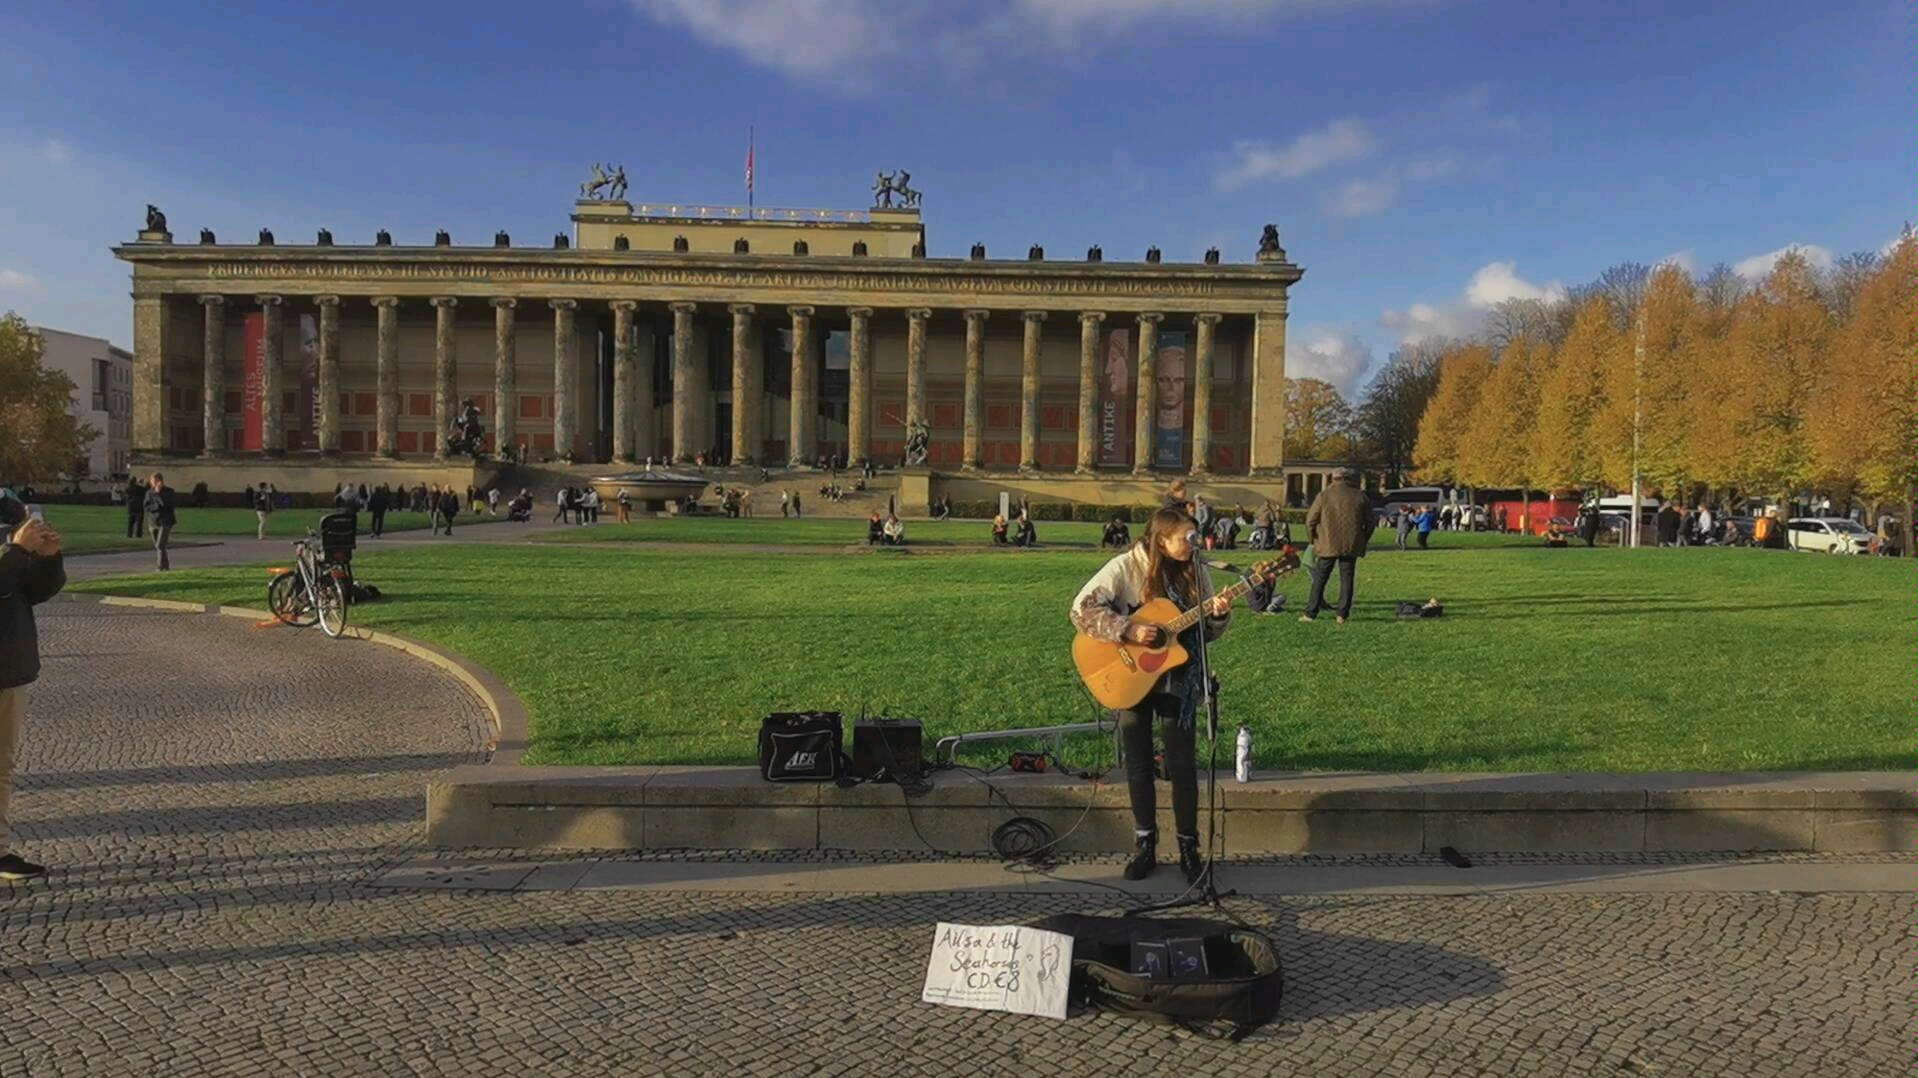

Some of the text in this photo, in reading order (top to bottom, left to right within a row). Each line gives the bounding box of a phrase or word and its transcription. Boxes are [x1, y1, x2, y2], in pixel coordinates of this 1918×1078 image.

[402, 265, 418, 278] III
[428, 265, 489, 278] STVDIO
[244, 371, 257, 412] ALTES
[1102, 399, 1115, 451] ANTIKE
[967, 972, 990, 989] CD
